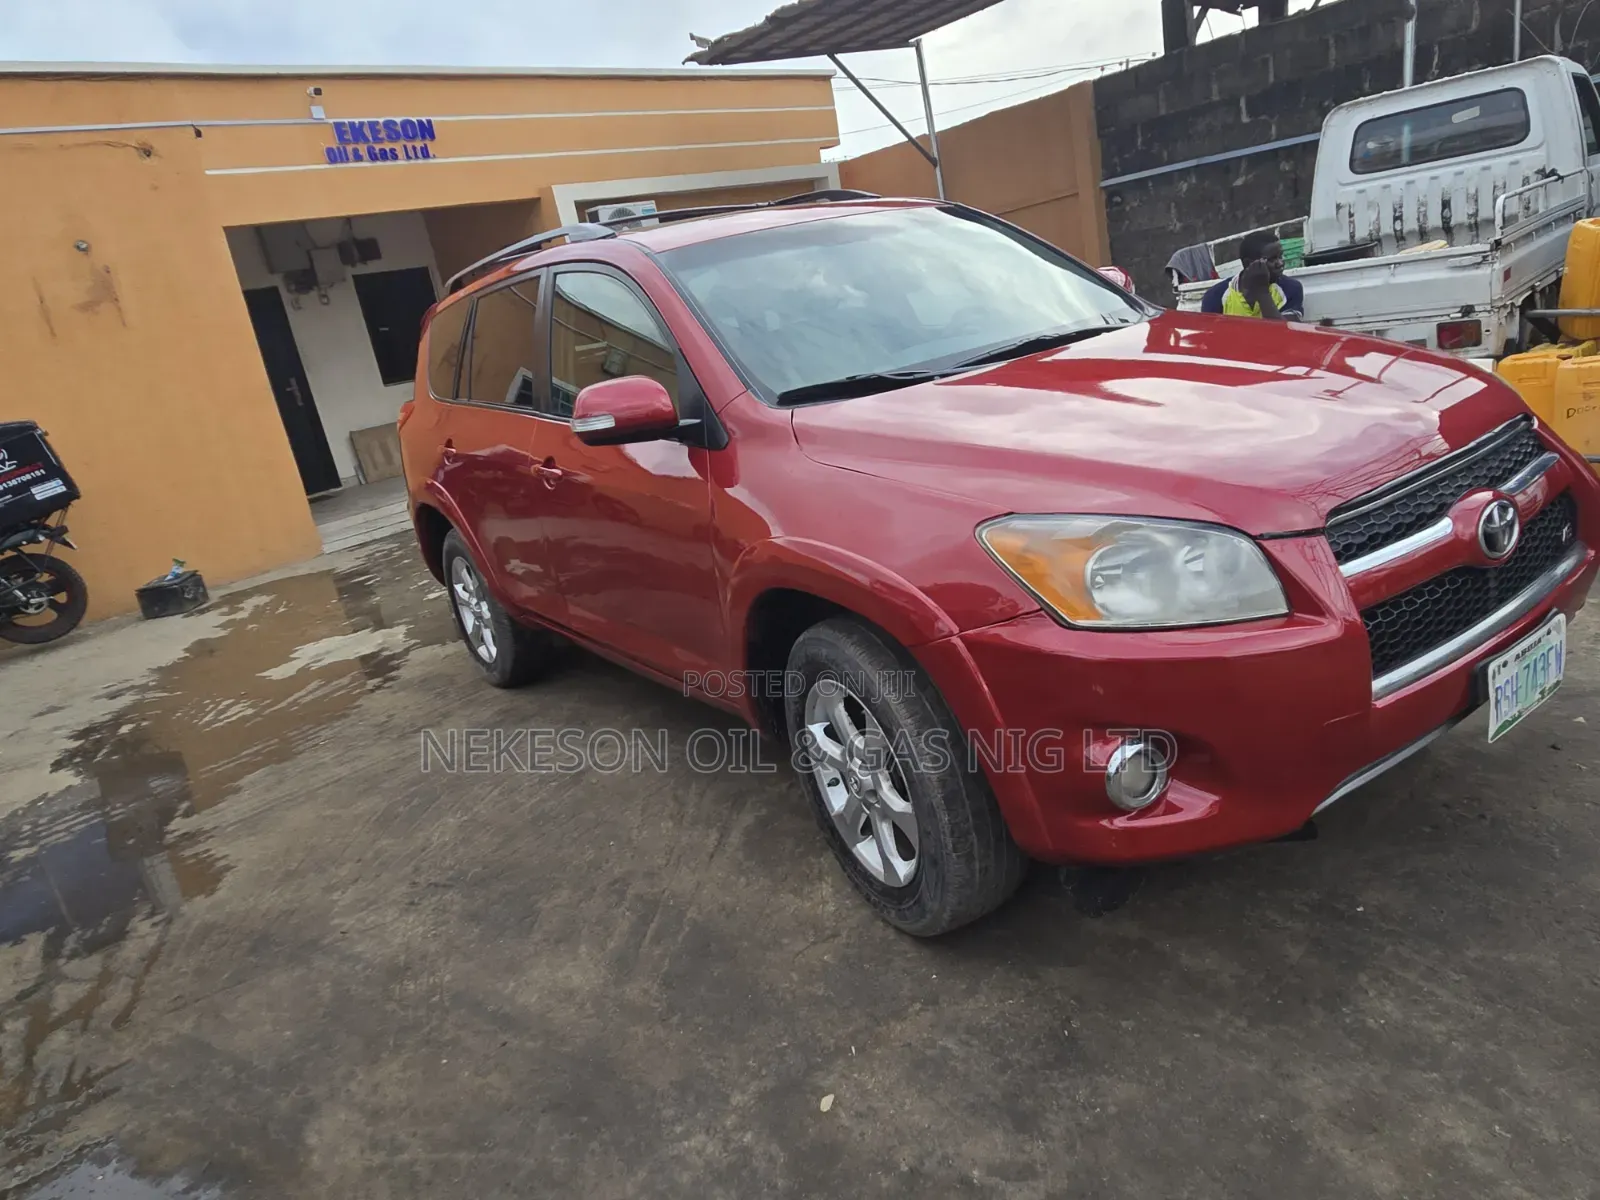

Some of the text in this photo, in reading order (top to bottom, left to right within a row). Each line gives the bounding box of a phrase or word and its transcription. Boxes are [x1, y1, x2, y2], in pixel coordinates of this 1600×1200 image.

[333, 119, 436, 144] EKESON
[325, 143, 436, 165] Oil & Gas Ltd.
